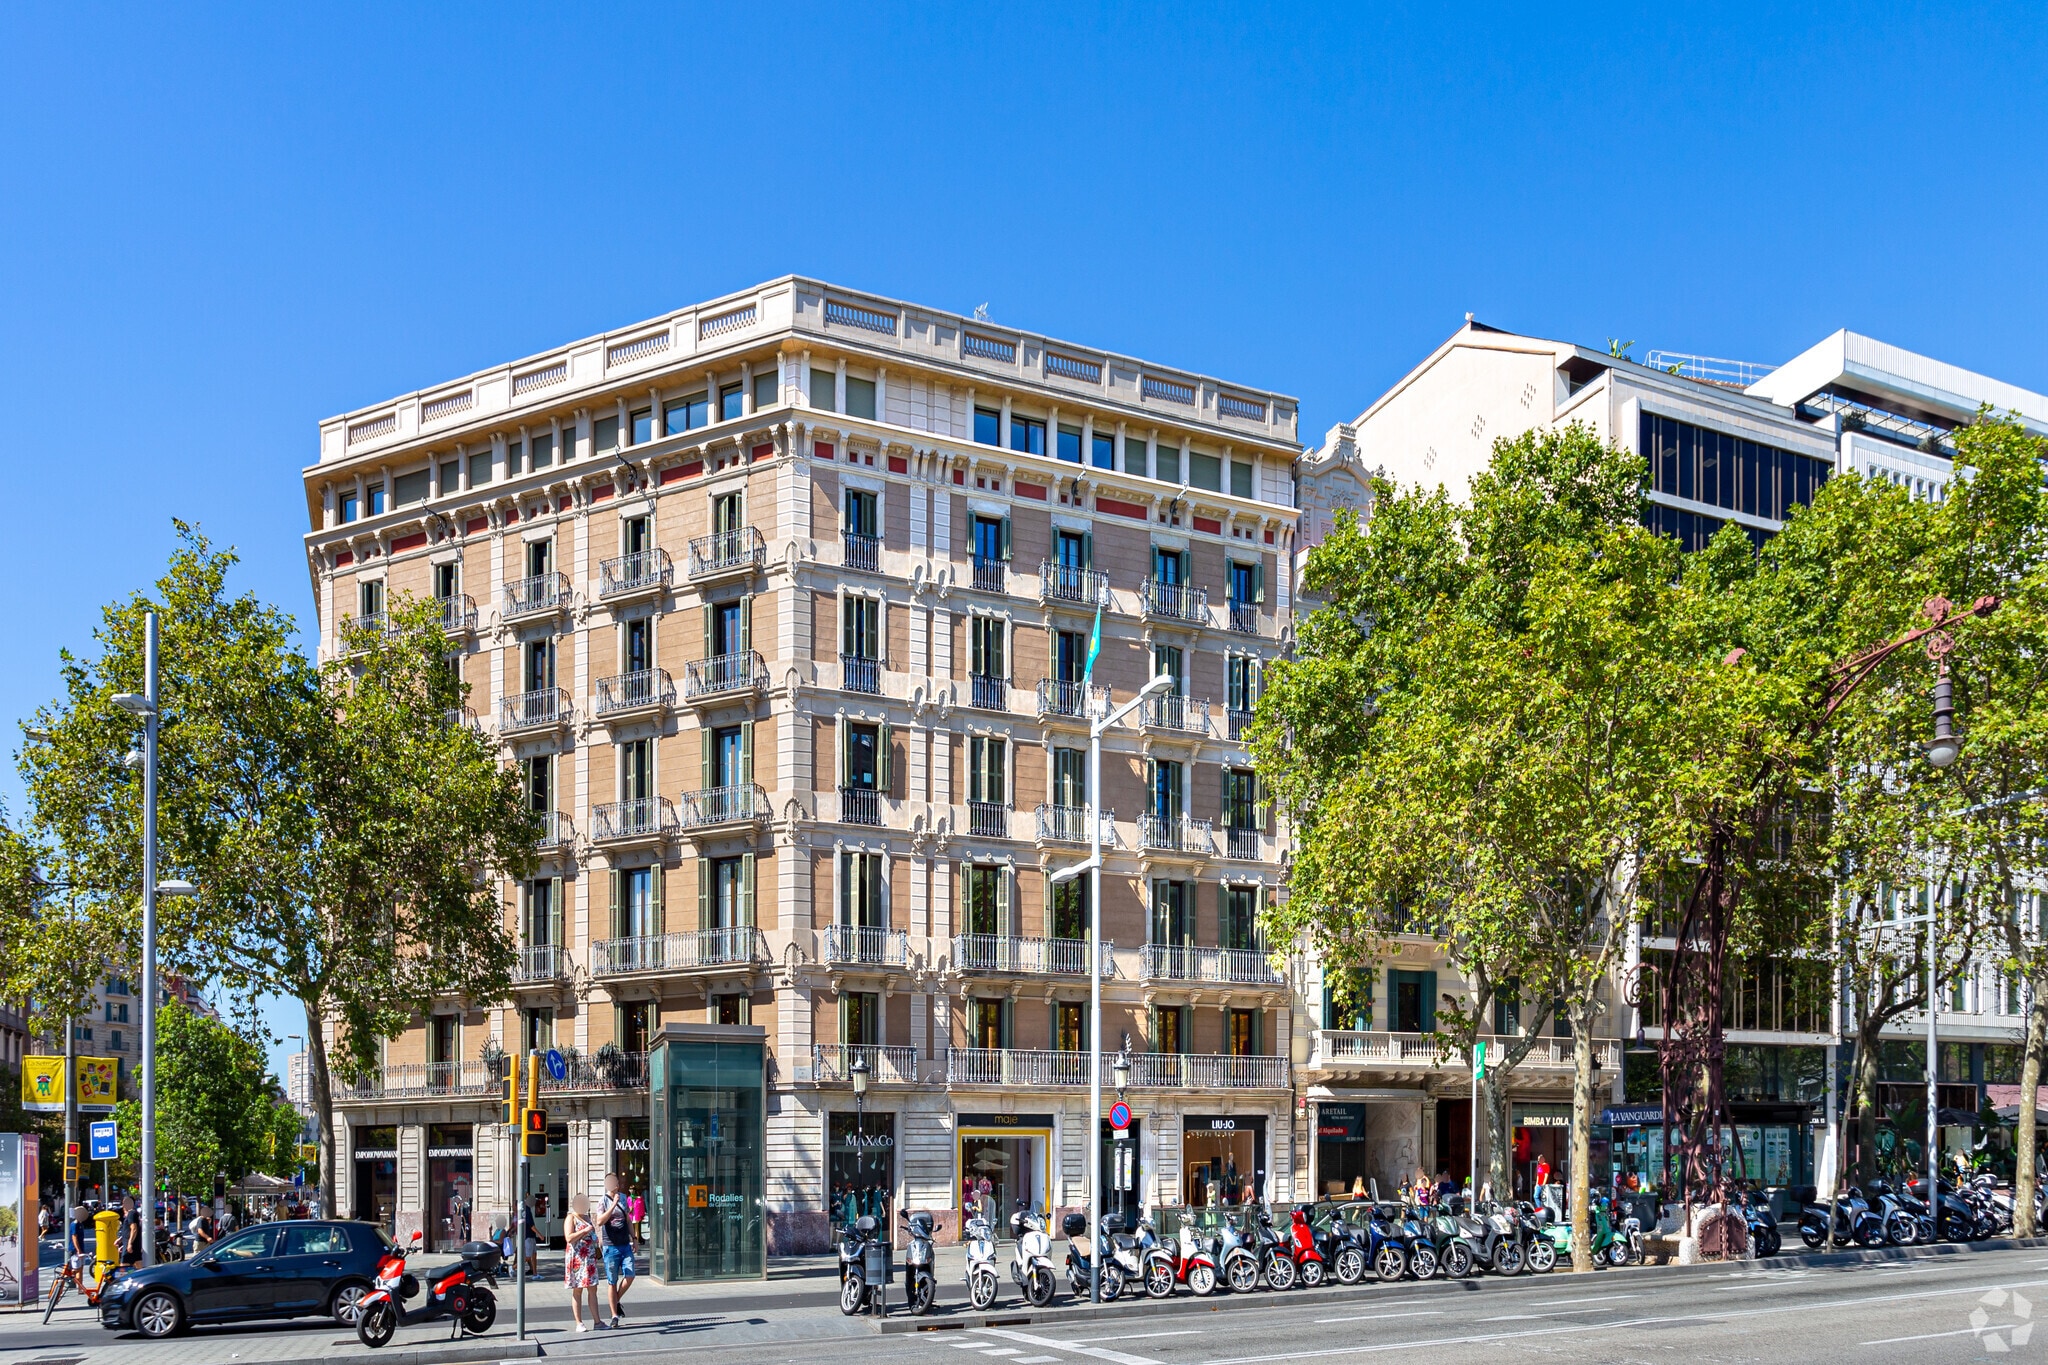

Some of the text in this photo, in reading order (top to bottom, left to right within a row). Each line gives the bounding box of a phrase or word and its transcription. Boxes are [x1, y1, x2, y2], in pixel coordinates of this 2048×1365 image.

[995, 1114, 1018, 1125] maje
[1523, 1116, 1569, 1126] BIMBA Y LOLA
[1611, 1110, 1664, 1122] LA VANGUARDI
[98, 1144, 110, 1154] taxi
[615, 1138, 650, 1151] MAX&C
[696, 1188, 744, 1202] R Rodalies
